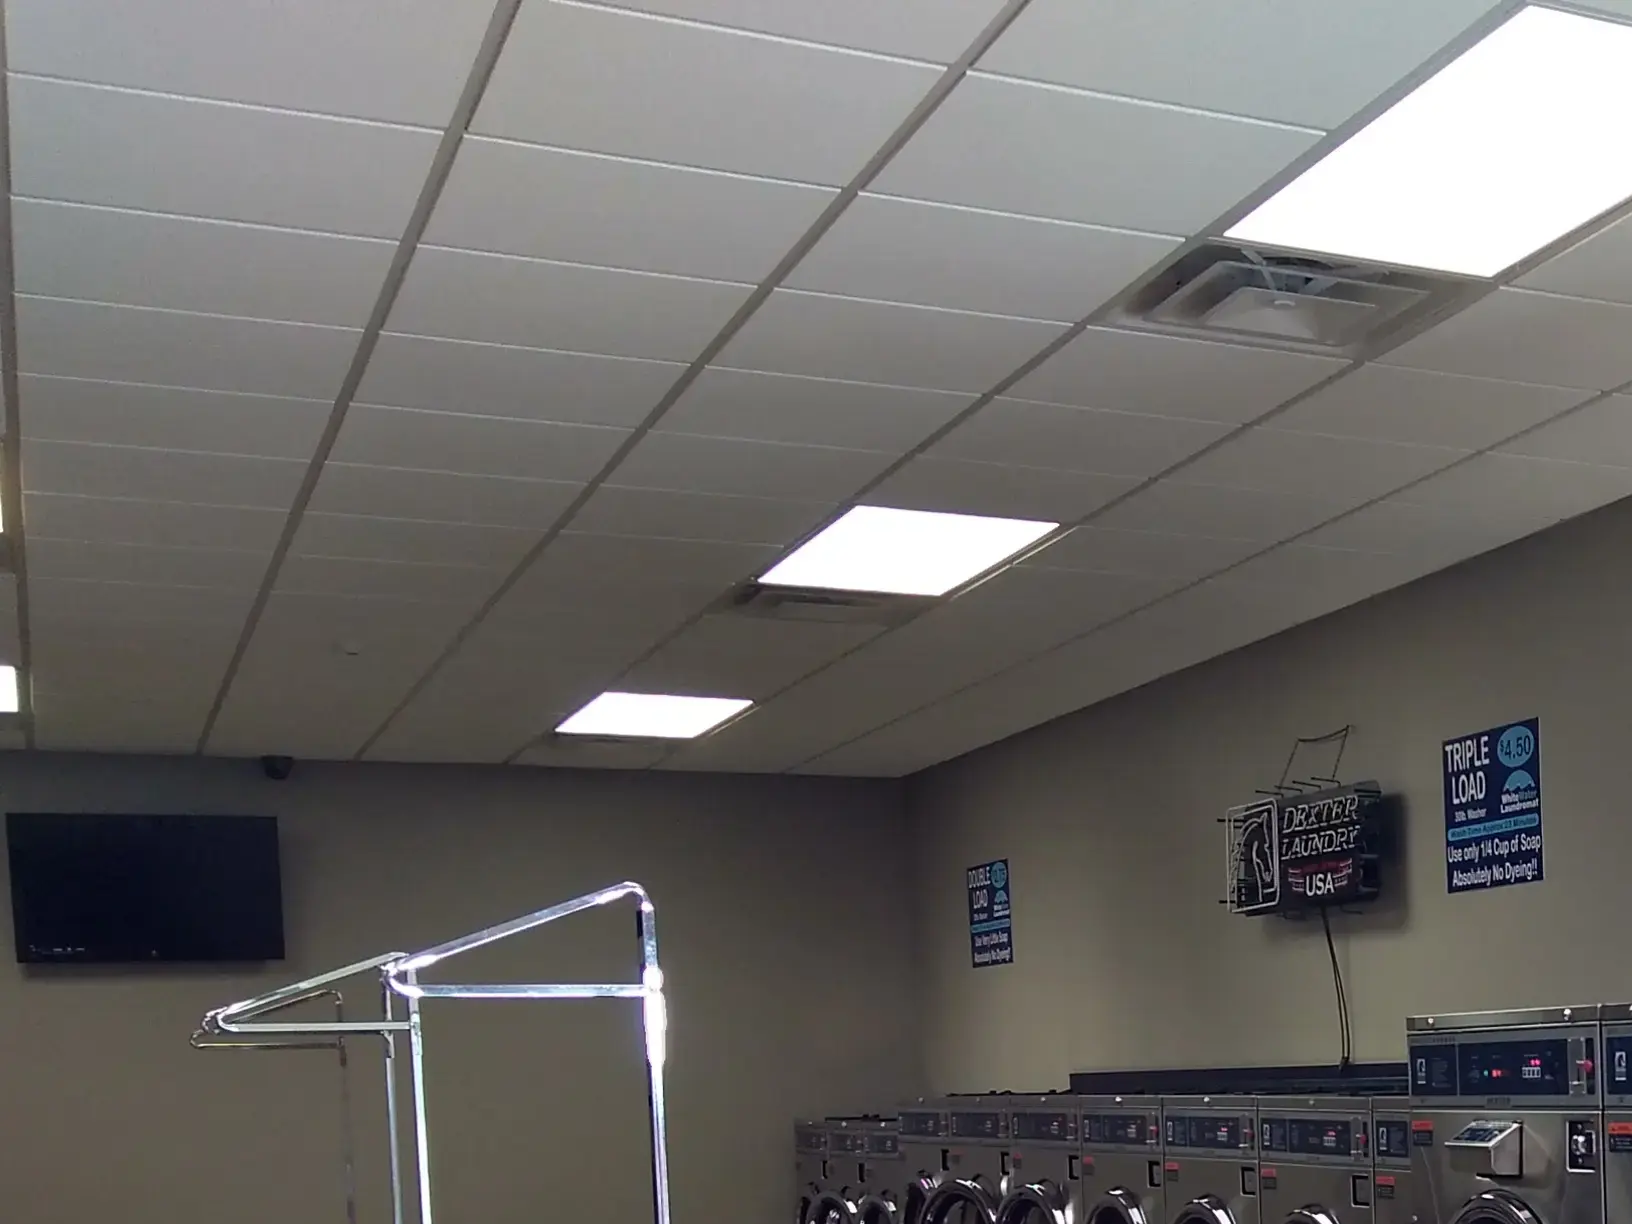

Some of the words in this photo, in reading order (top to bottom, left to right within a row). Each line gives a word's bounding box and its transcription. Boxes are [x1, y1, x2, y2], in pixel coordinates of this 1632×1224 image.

[1445, 735, 1490, 773] TRIPLE
[1500, 734, 1531, 761] $4.50
[1451, 770, 1486, 805] LOAD
[1283, 795, 1359, 834] DEXTER
[1281, 825, 1360, 860] LAUNDRY
[1447, 846, 1463, 863] Use
[1463, 842, 1479, 863] only
[1493, 838, 1509, 857] Cup
[1510, 834, 1519, 853] of
[1520, 833, 1541, 852] Soap
[1305, 872, 1335, 897] USA
[1452, 866, 1492, 887] Absolutely
[1492, 864, 1504, 881] No
